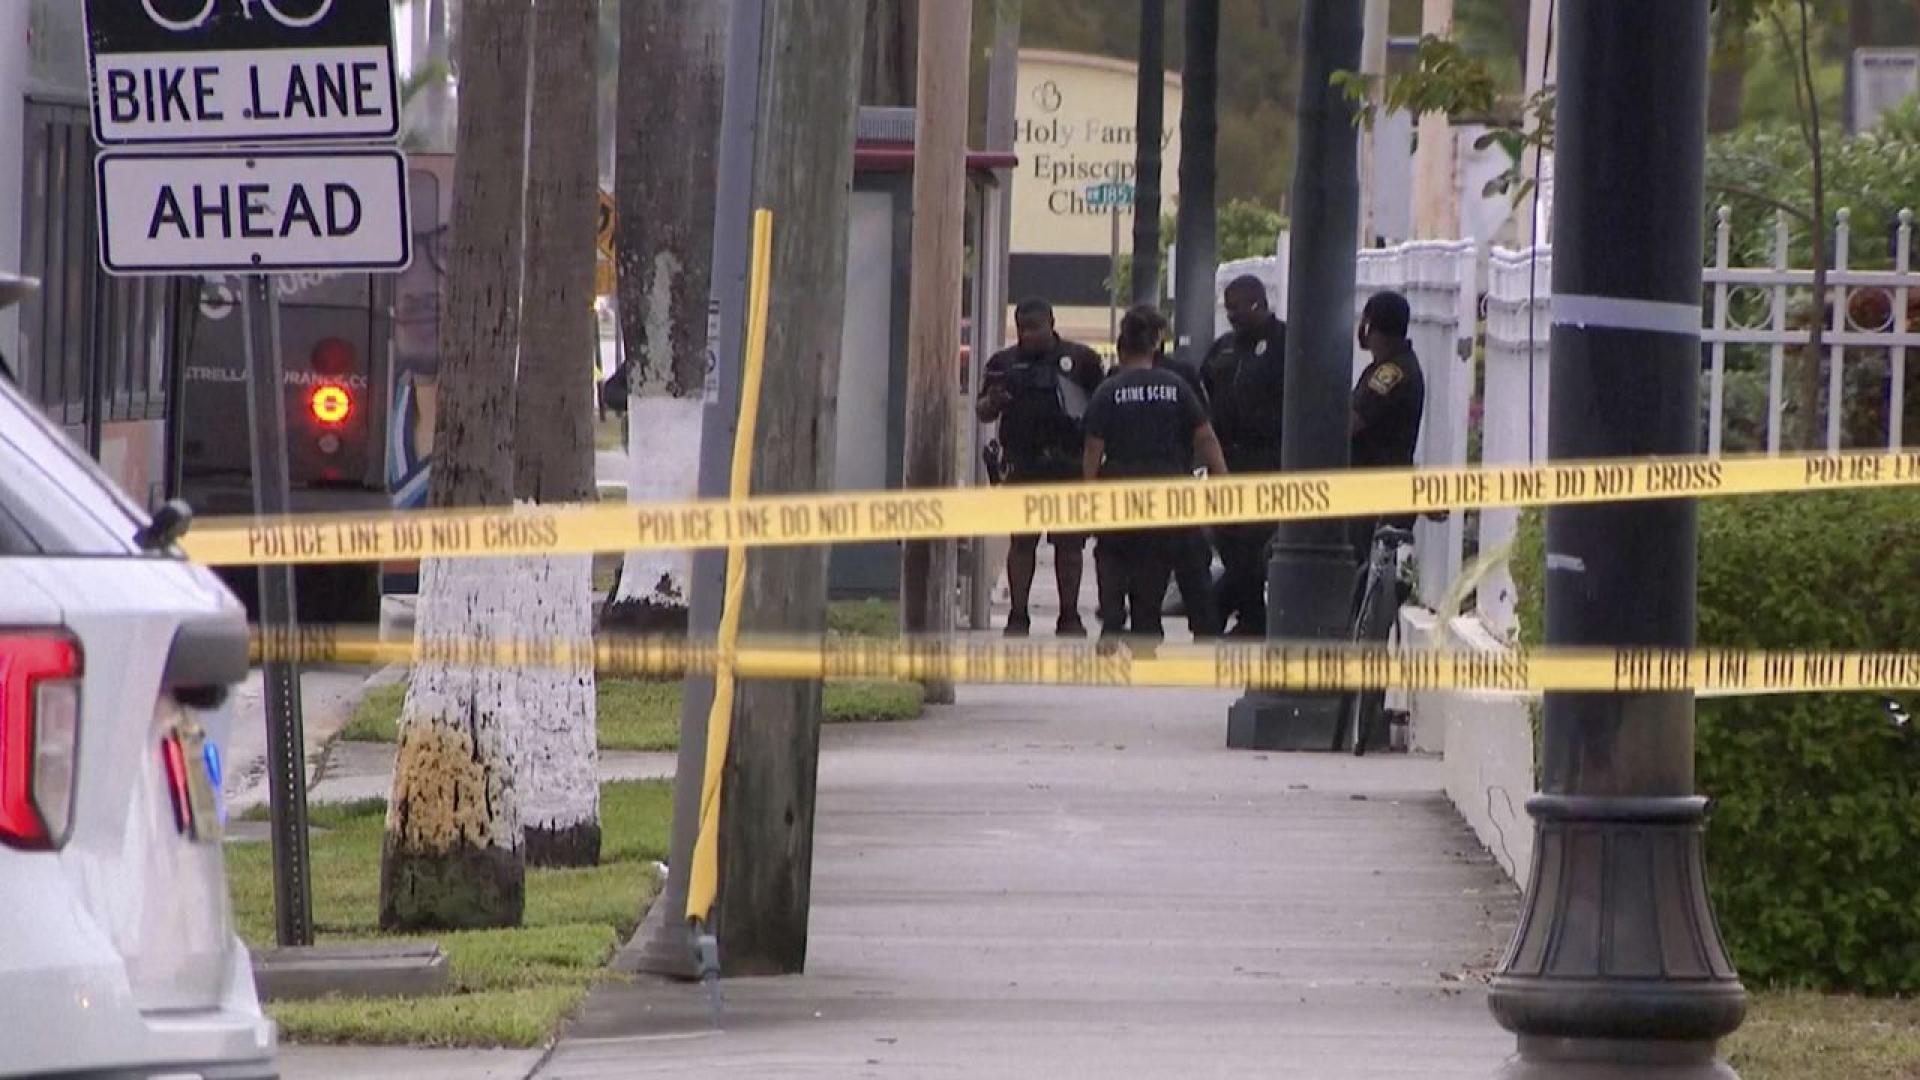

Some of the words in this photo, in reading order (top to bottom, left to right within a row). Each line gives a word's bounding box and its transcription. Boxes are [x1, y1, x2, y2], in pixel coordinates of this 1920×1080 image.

[107, 65, 224, 123] BIKE
[249, 62, 382, 120] LANE
[1014, 119, 1075, 149] Holy
[1086, 118, 1174, 150] Famy
[1034, 153, 1136, 184] Episcop
[147, 183, 362, 239] AHEAD
[1115, 386, 1145, 405] CRIME
[1147, 384, 1177, 402] SCENE
[1412, 472, 1489, 506] POLICE
[1499, 467, 1547, 501] LINE
[1556, 466, 1586, 498] DO
[1594, 464, 1635, 495] NOT
[1646, 460, 1722, 492] CROSS
[1806, 455, 1881, 484] POLICE
[1895, 453, 1920, 480] LI
[638, 508, 715, 543] POLICE
[725, 505, 770, 539] LINE
[780, 504, 810, 537] DO
[817, 502, 860, 535] NOT
[869, 499, 945, 533] CROSS
[1024, 491, 1101, 525] POLICE
[1111, 486, 1158, 522] LINE
[1167, 485, 1196, 519] DO
[1205, 484, 1245, 516] NOT
[1256, 480, 1331, 514] CROSS
[249, 522, 326, 557] POLICE
[336, 519, 382, 554] LINE
[392, 518, 424, 552] DO
[431, 516, 472, 549] NOT
[482, 514, 559, 548] CROSS
[1056, 640, 1132, 685] CROSS
[1215, 645, 1289, 688] POLICE
[1303, 646, 1347, 688] LINE
[1361, 646, 1391, 688] DO
[1400, 646, 1441, 690] NOT
[1454, 645, 1529, 690] CROSS
[1615, 648, 1691, 690] POLICE
[1705, 648, 1749, 688] LINE
[1763, 648, 1795, 688] DO
[1803, 649, 1846, 688] NOT
[1859, 649, 1920, 687] CROS
